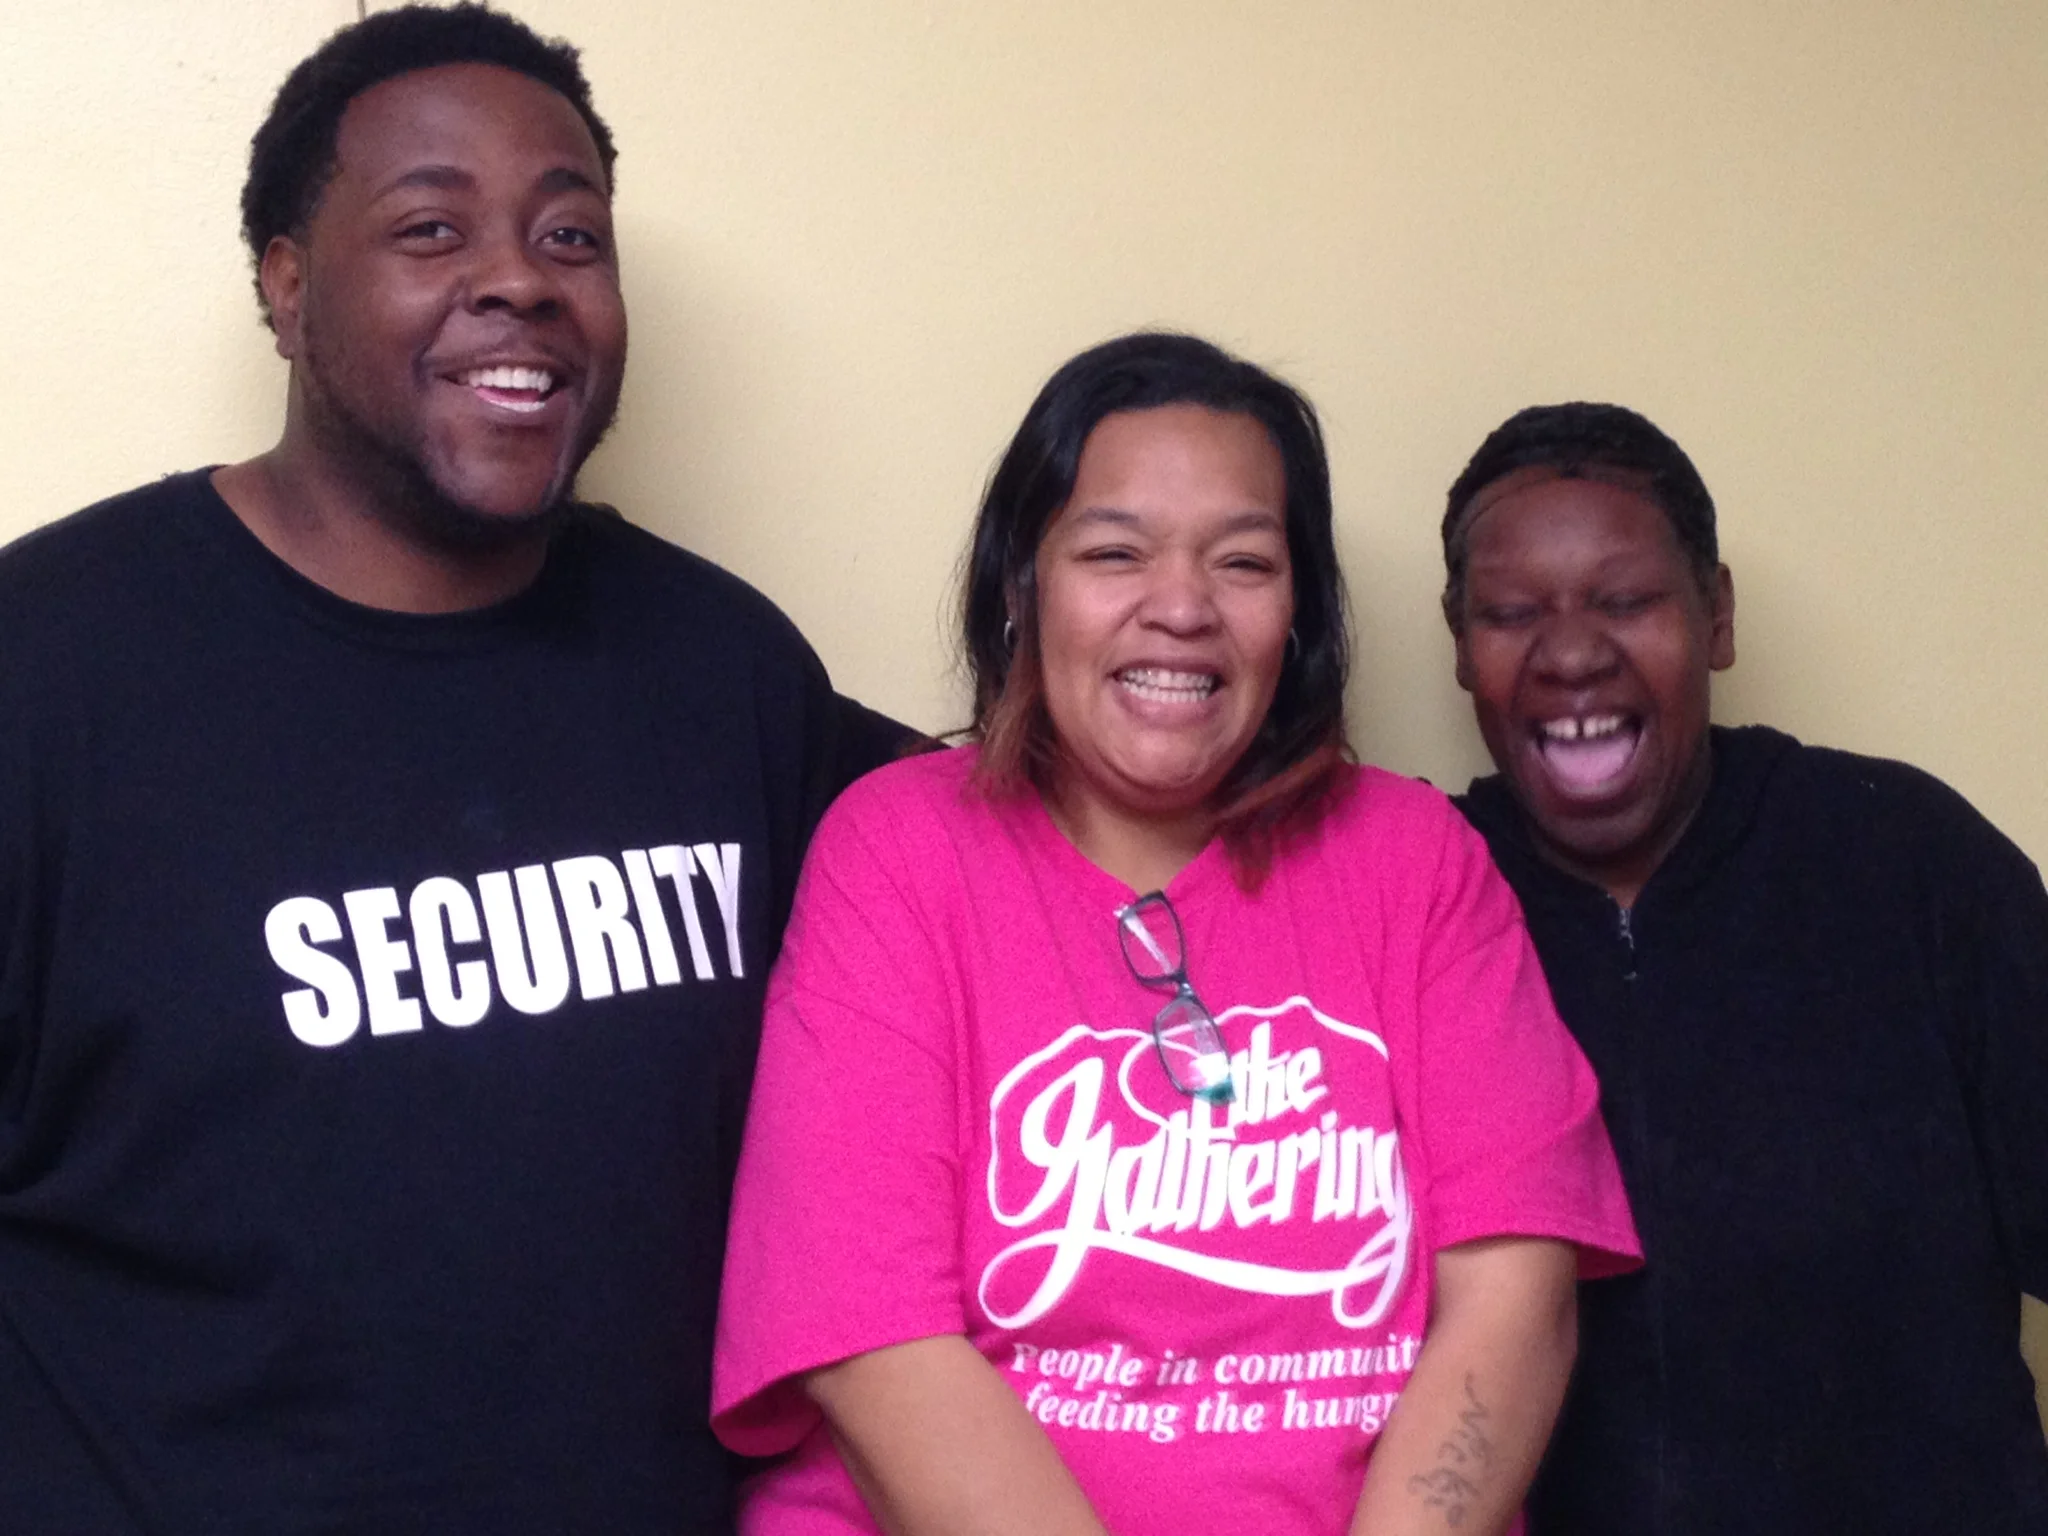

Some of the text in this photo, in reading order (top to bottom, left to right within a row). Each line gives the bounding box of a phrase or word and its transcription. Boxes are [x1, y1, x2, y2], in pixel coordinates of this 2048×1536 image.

[264, 842, 745, 1048] SECURITY
[1227, 1020, 1329, 1125] the
[979, 1056, 1412, 1329] Gathering
[1011, 1332, 1421, 1391] People in communit
[1025, 1382, 1399, 1444] feeding the hungr
